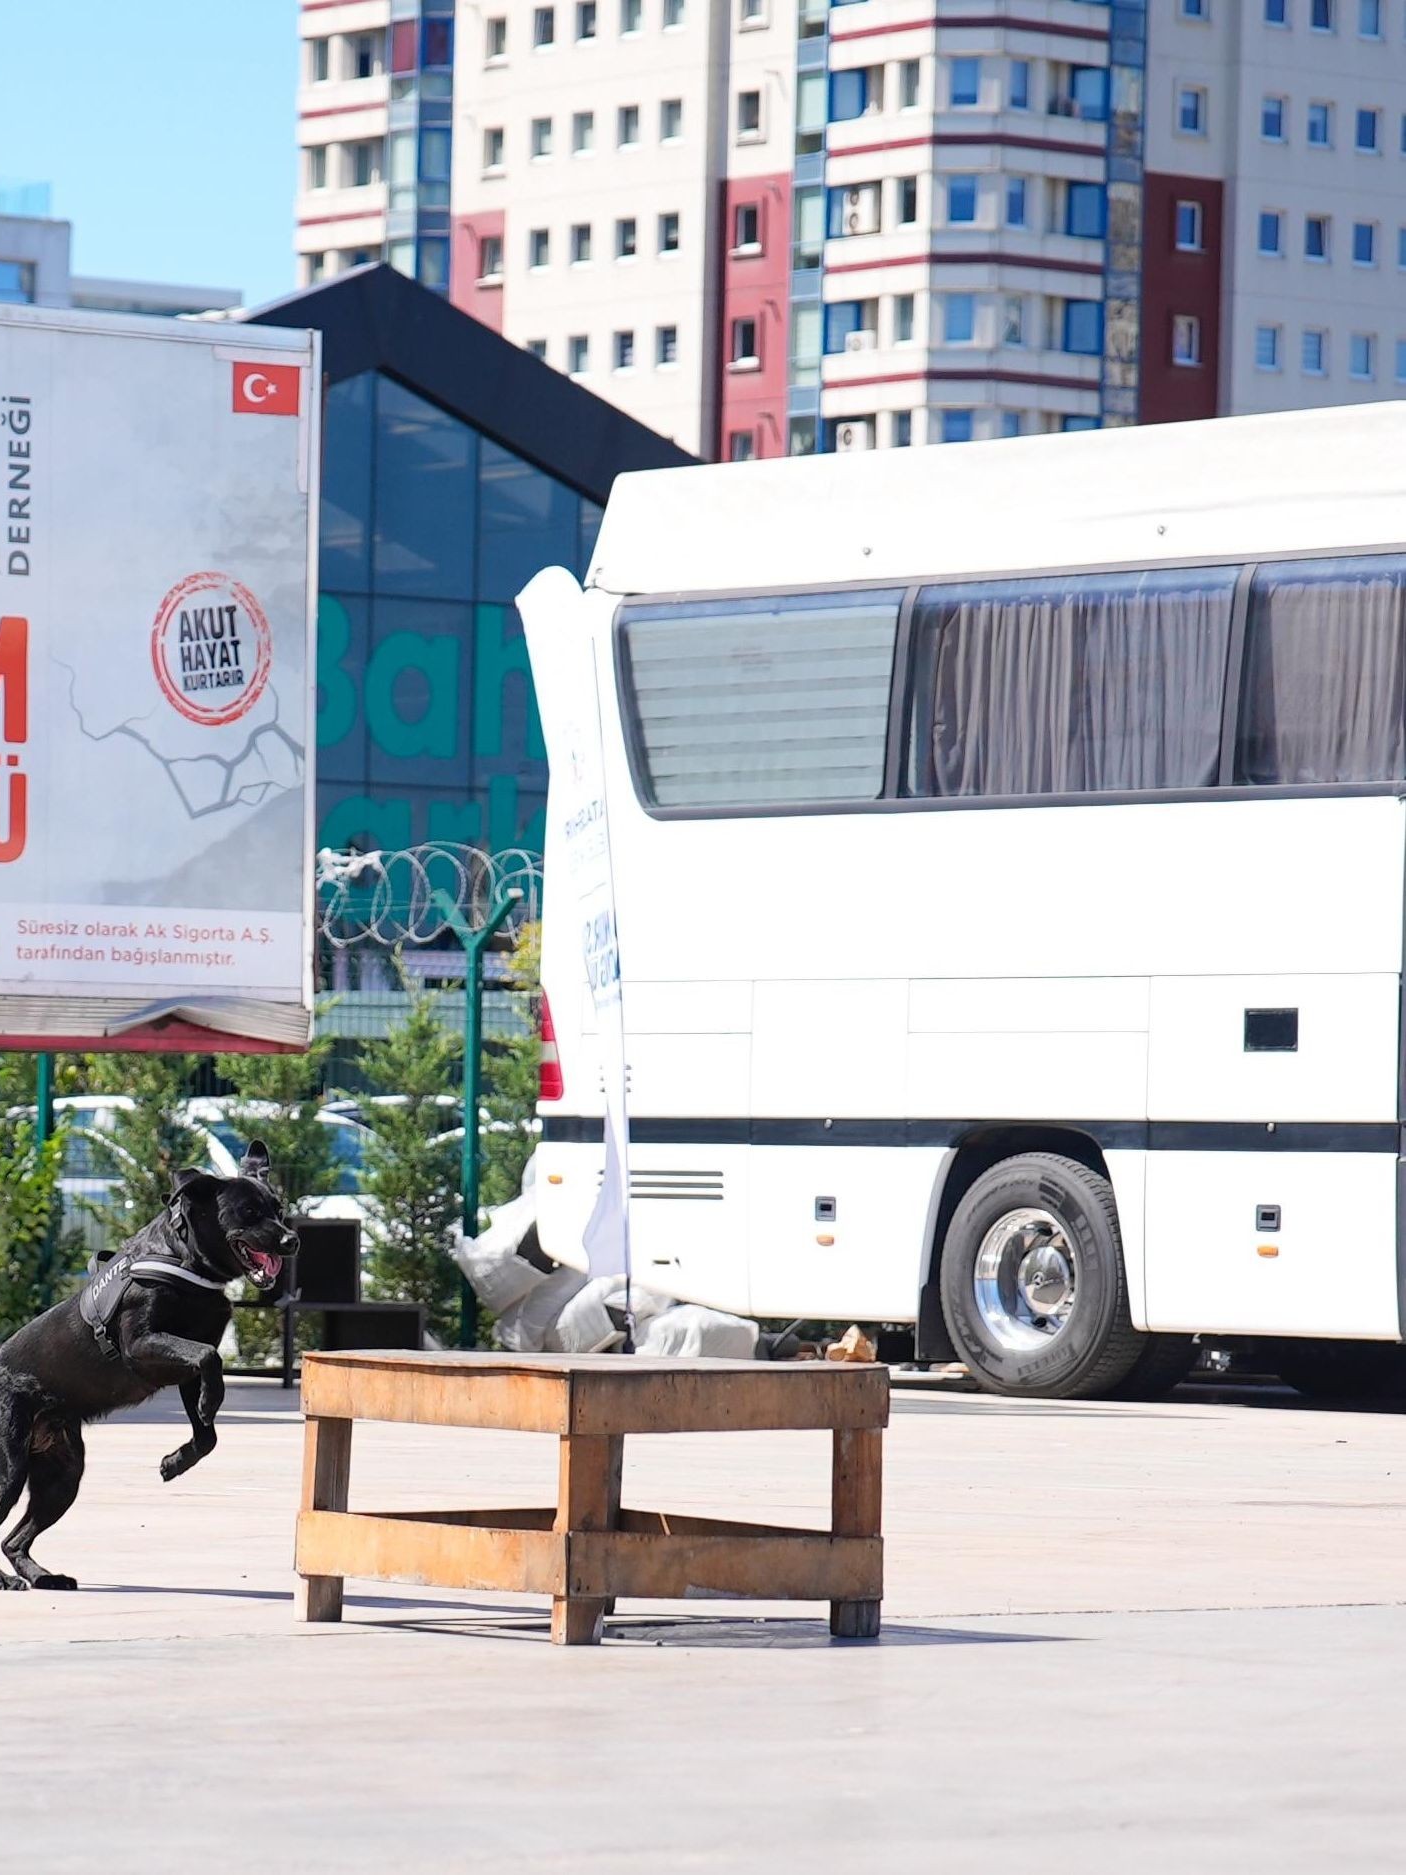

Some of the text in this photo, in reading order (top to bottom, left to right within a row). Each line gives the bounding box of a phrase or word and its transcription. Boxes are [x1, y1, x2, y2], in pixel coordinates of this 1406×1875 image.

[0, 395, 32, 577] DERNEĞİ
[180, 605, 237, 644] AKUT
[180, 640, 242, 673] HAYAT
[182, 669, 247, 692] KURTARIR
[17, 919, 275, 945] Süresiz olarak Ak Sigorta A.Ş.
[16, 944, 237, 968] tarafından bağışlanmıştır.
[92, 1255, 128, 1301] DANTE
